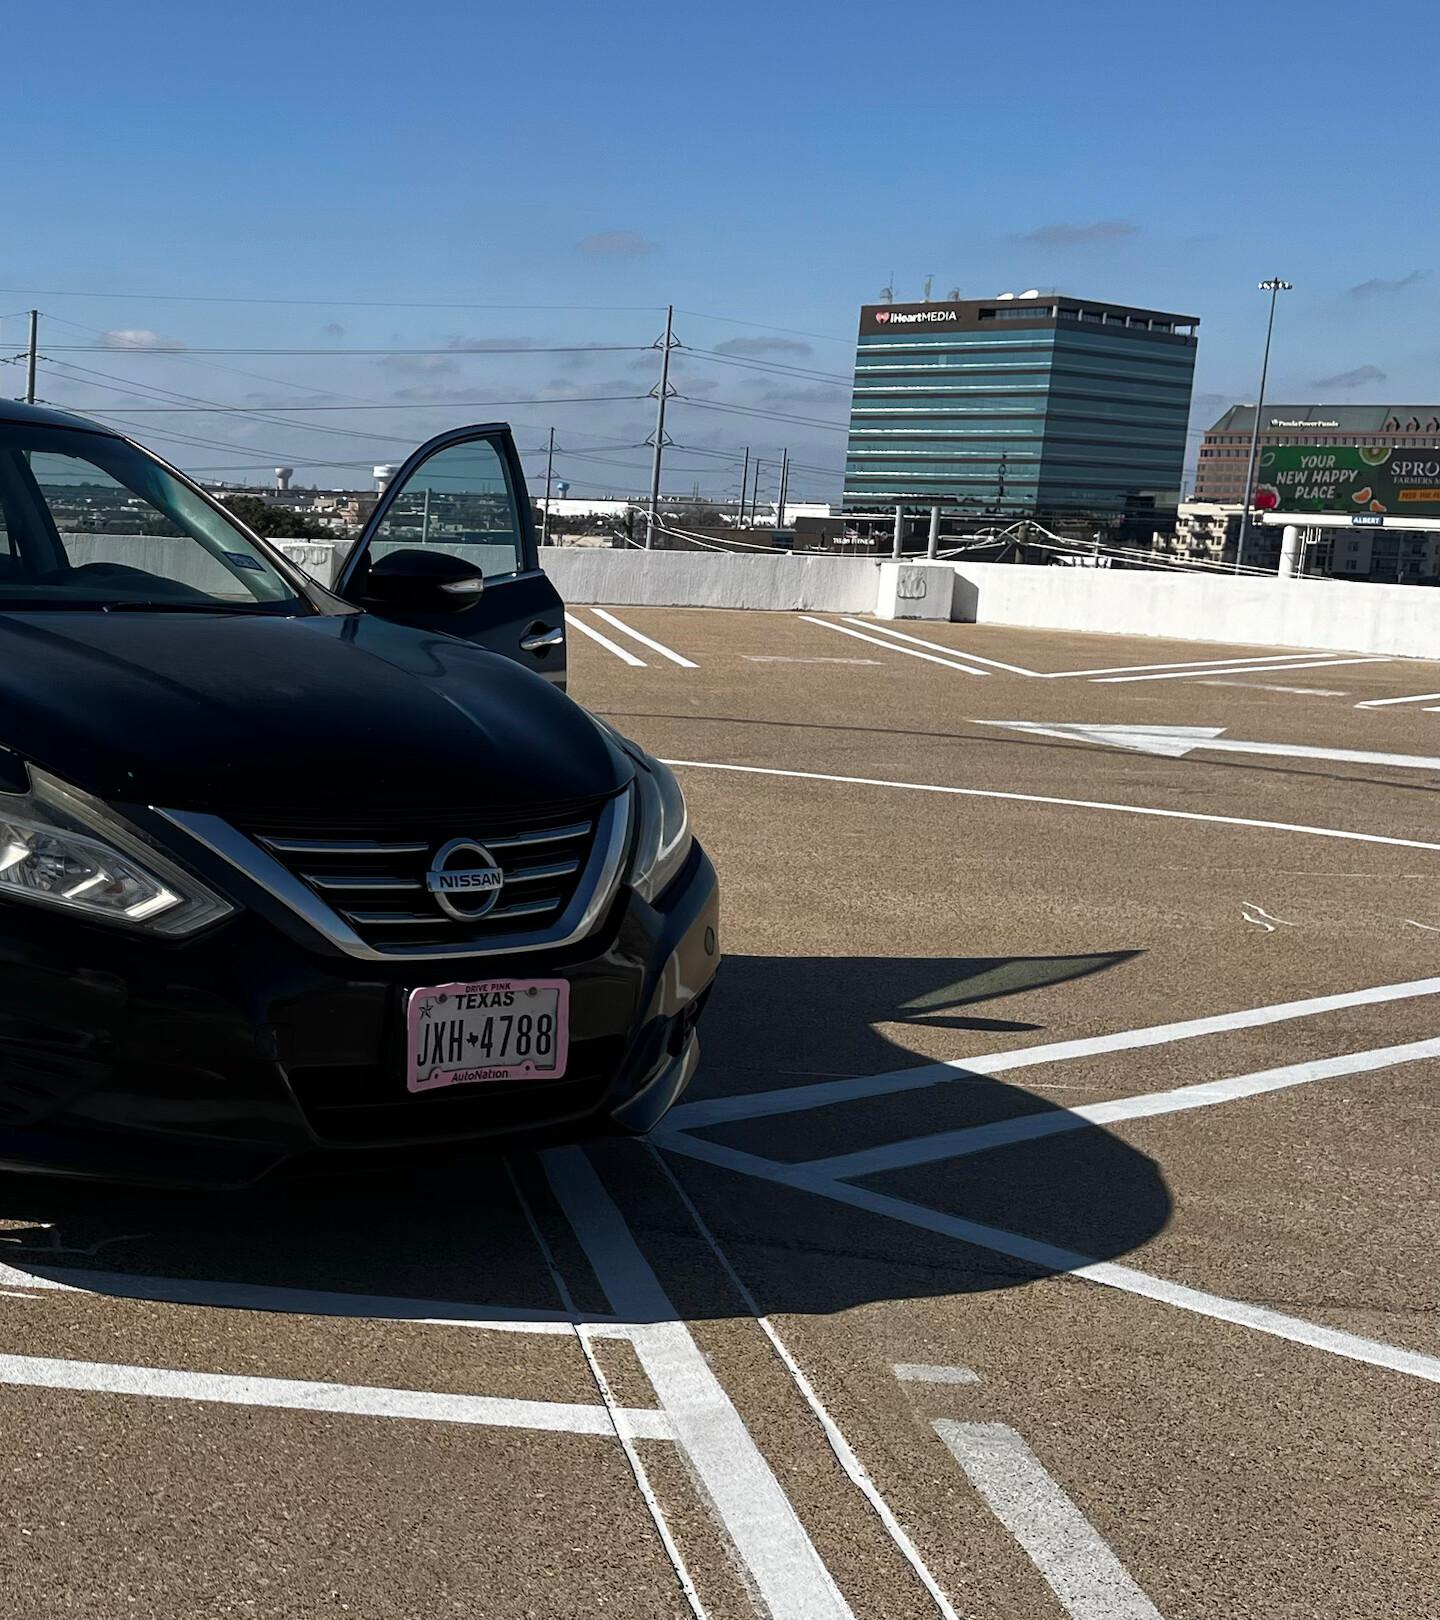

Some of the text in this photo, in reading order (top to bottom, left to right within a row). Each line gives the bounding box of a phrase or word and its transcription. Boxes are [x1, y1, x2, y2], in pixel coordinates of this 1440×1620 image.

[1301, 455, 1336, 469] YOUR
[1391, 461, 1440, 477] SPRO
[1276, 469, 1359, 485] NEW HAPPY
[1393, 476, 1432, 485] FARMERS
[1295, 486, 1336, 499] PLACE
[440, 873, 501, 888] NISSAN
[465, 983, 511, 993] DRIVE PINK
[456, 992, 515, 1010] TEXAS
[451, 1070, 509, 1082] AutoNation
